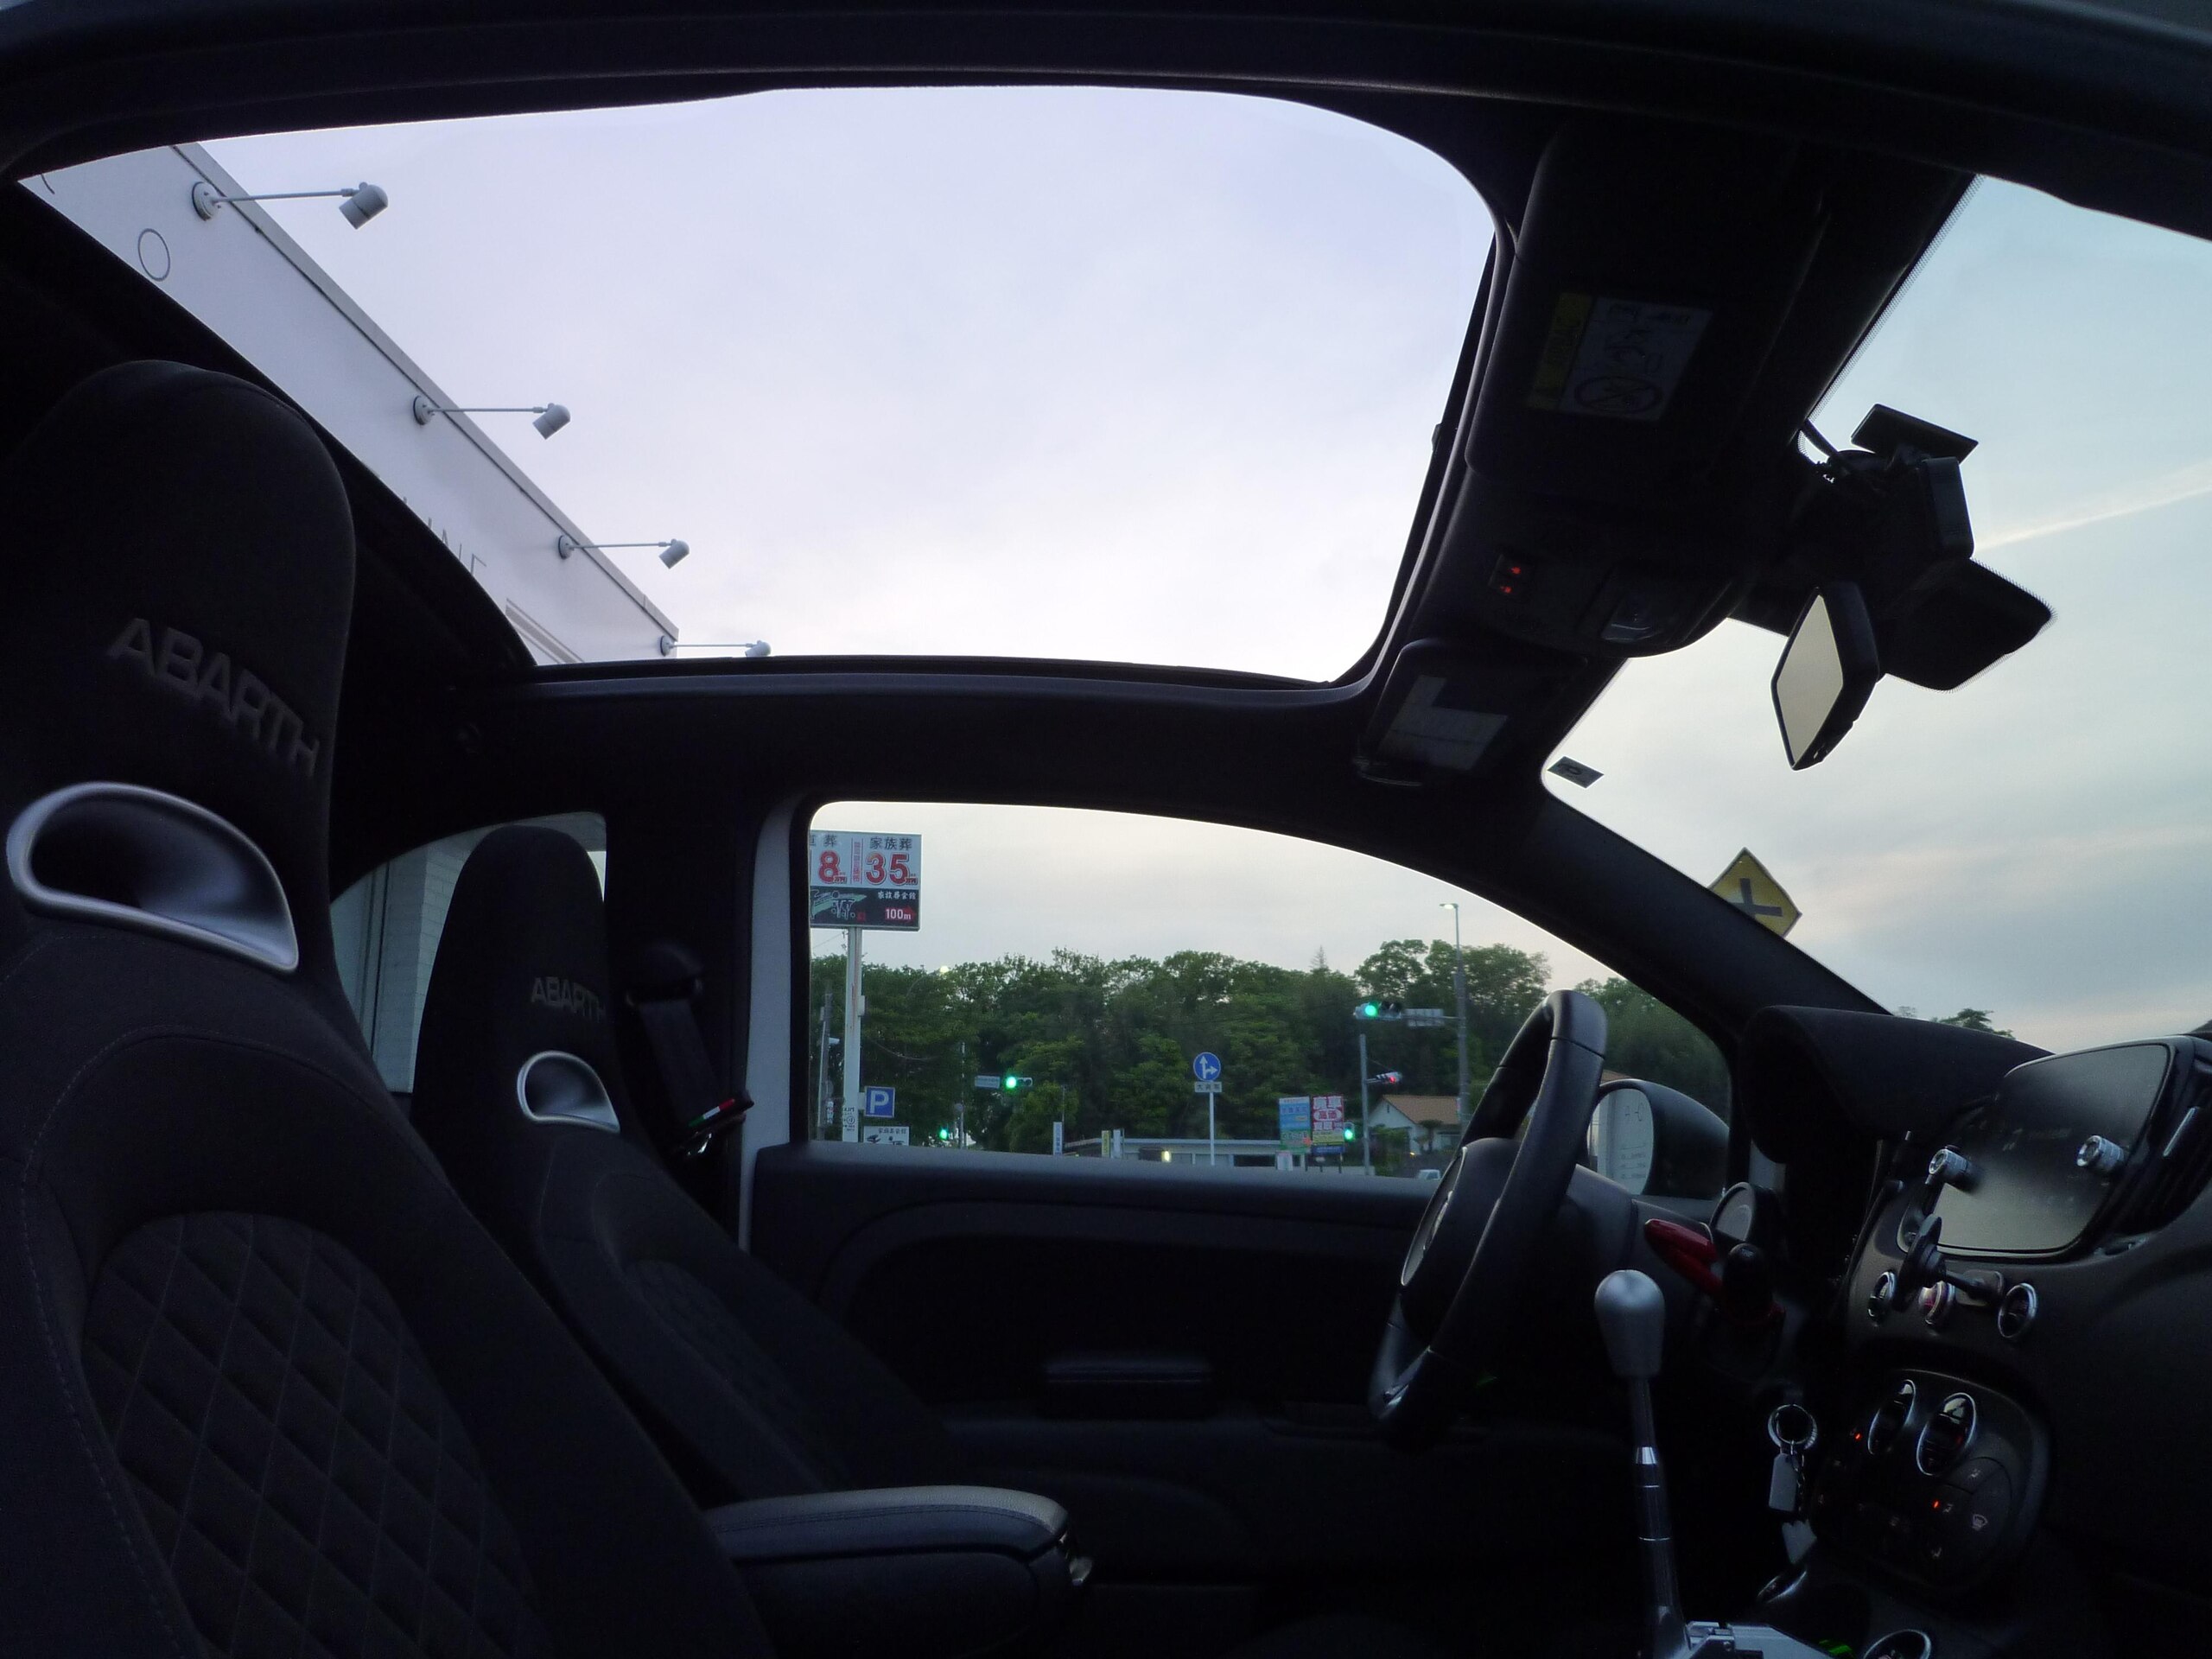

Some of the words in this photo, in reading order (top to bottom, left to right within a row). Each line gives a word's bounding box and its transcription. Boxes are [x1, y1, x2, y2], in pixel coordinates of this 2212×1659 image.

[105, 617, 321, 778] ABARTH
[870, 836, 912, 850] 家族葬
[886, 908, 912, 920] 100m
[531, 976, 607, 1024] ABARTH
[869, 1090, 889, 1114] P
